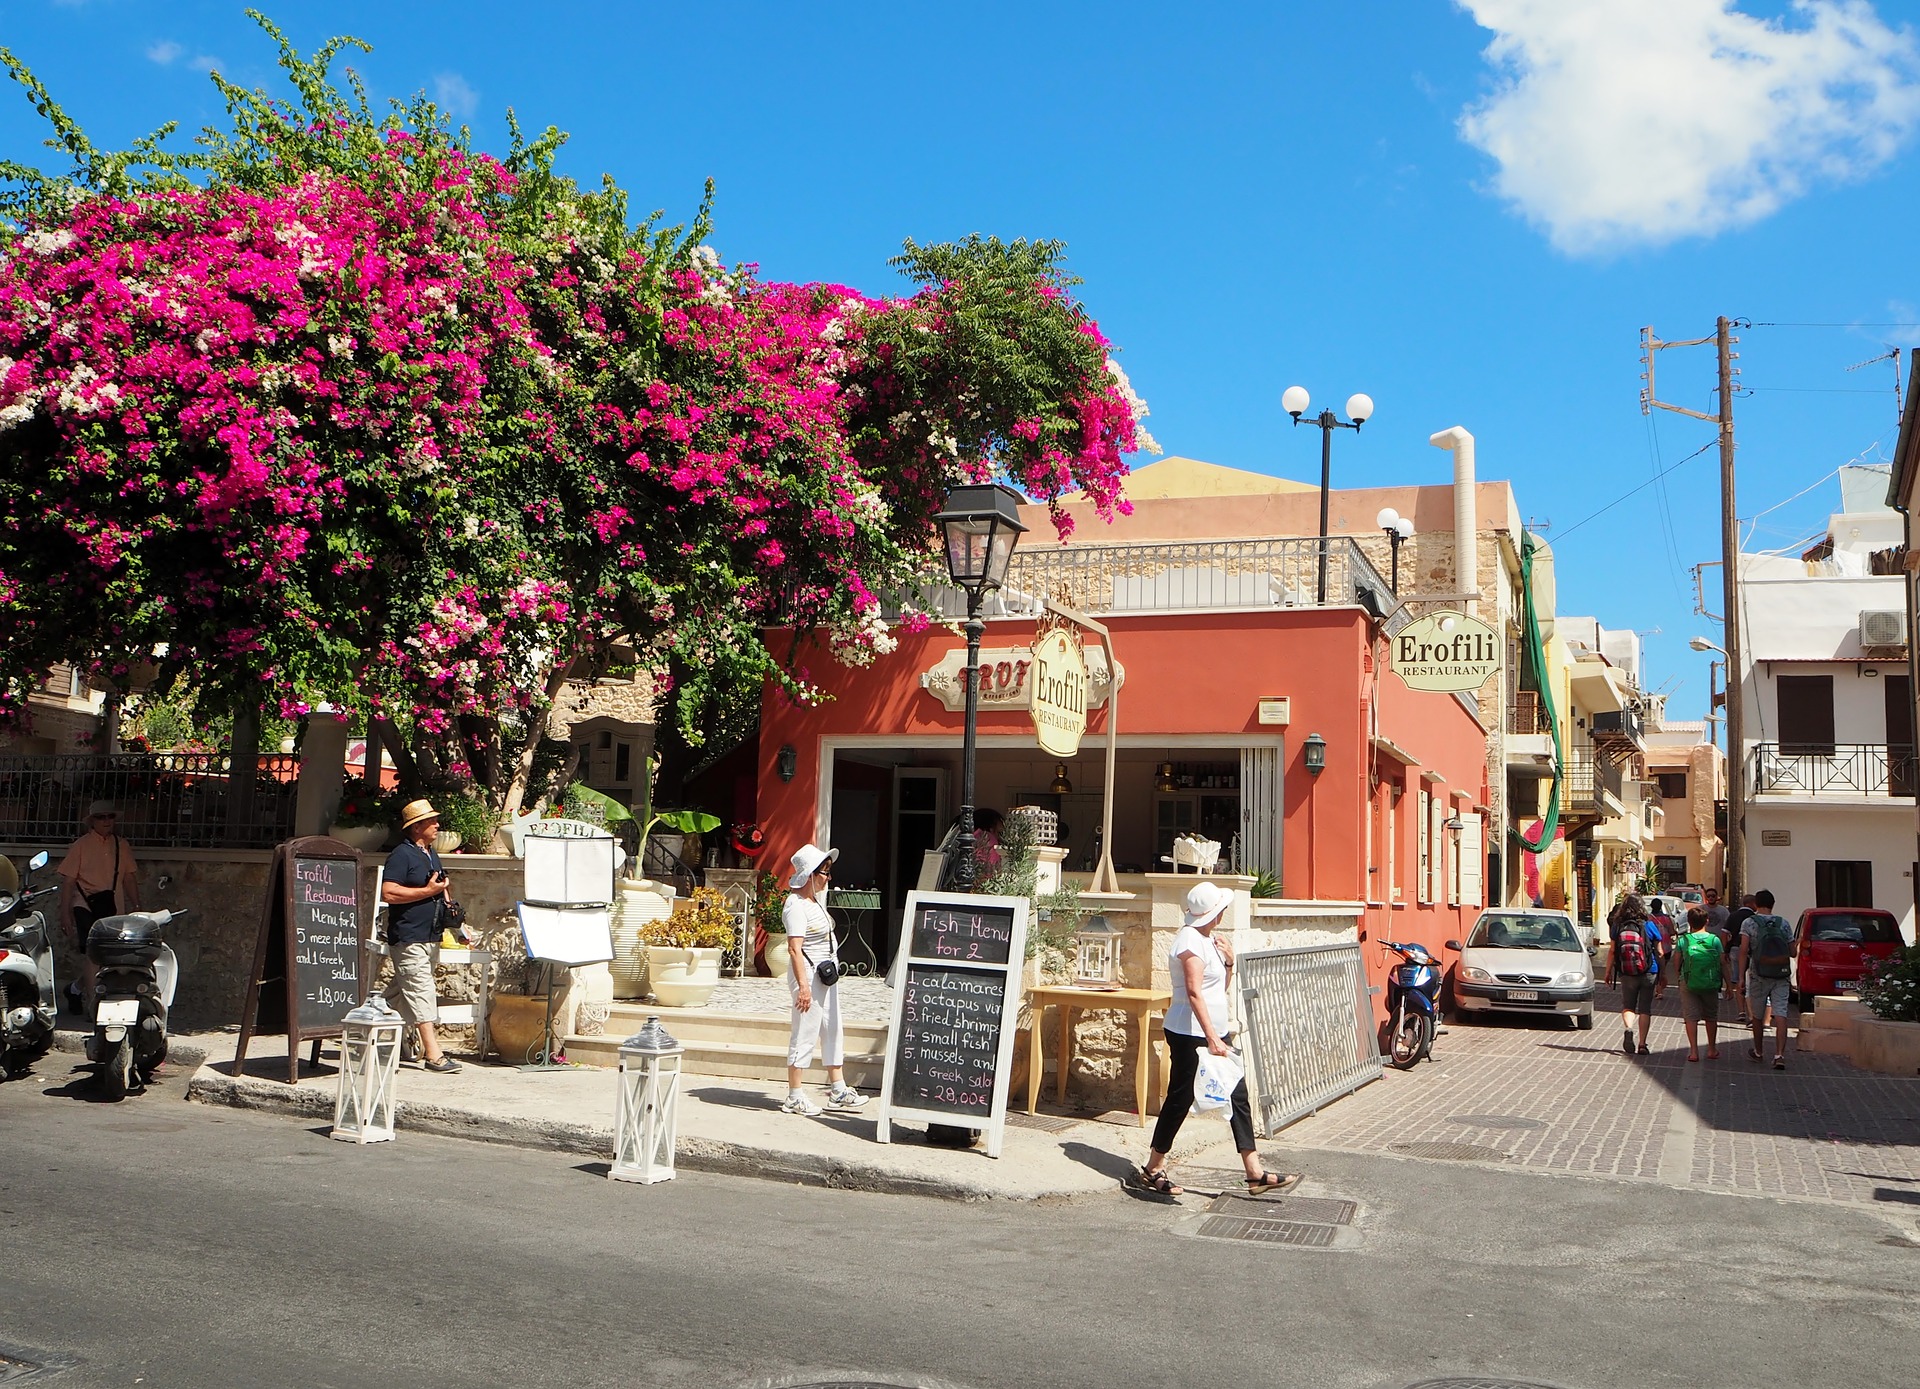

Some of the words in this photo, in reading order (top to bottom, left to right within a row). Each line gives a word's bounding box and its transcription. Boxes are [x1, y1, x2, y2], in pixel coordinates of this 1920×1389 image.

[1398, 634, 1495, 663] Erofili
[1403, 666, 1489, 676] RESTAURANT
[1037, 658, 1084, 715] Erofili
[1039, 709, 1081, 734] RESTAURANT
[529, 822, 597, 838] EROFILI
[296, 863, 333, 885] Erofili
[305, 884, 356, 906] Restaurant
[311, 907, 338, 926] Menu
[339, 911, 349, 927] for
[349, 912, 357, 929] 2
[923, 909, 959, 934] Fish
[970, 914, 1010, 942] Menu
[296, 927, 306, 943] 5
[310, 934, 331, 945] meze
[333, 931, 357, 953] plates
[936, 935, 962, 957] for
[966, 942, 984, 959] 2
[296, 947, 311, 964] and
[312, 950, 319, 965] 1
[319, 951, 344, 966] Greek
[331, 961, 357, 980] salad
[922, 972, 1004, 997] calamares
[921, 1007, 952, 1026] fried
[921, 1029, 957, 1046] small
[962, 1032, 990, 1051] fish
[920, 1047, 965, 1066] mussels
[973, 1054, 996, 1072] and
[928, 1066, 963, 1084] Greek
[968, 1072, 993, 1089] sala
